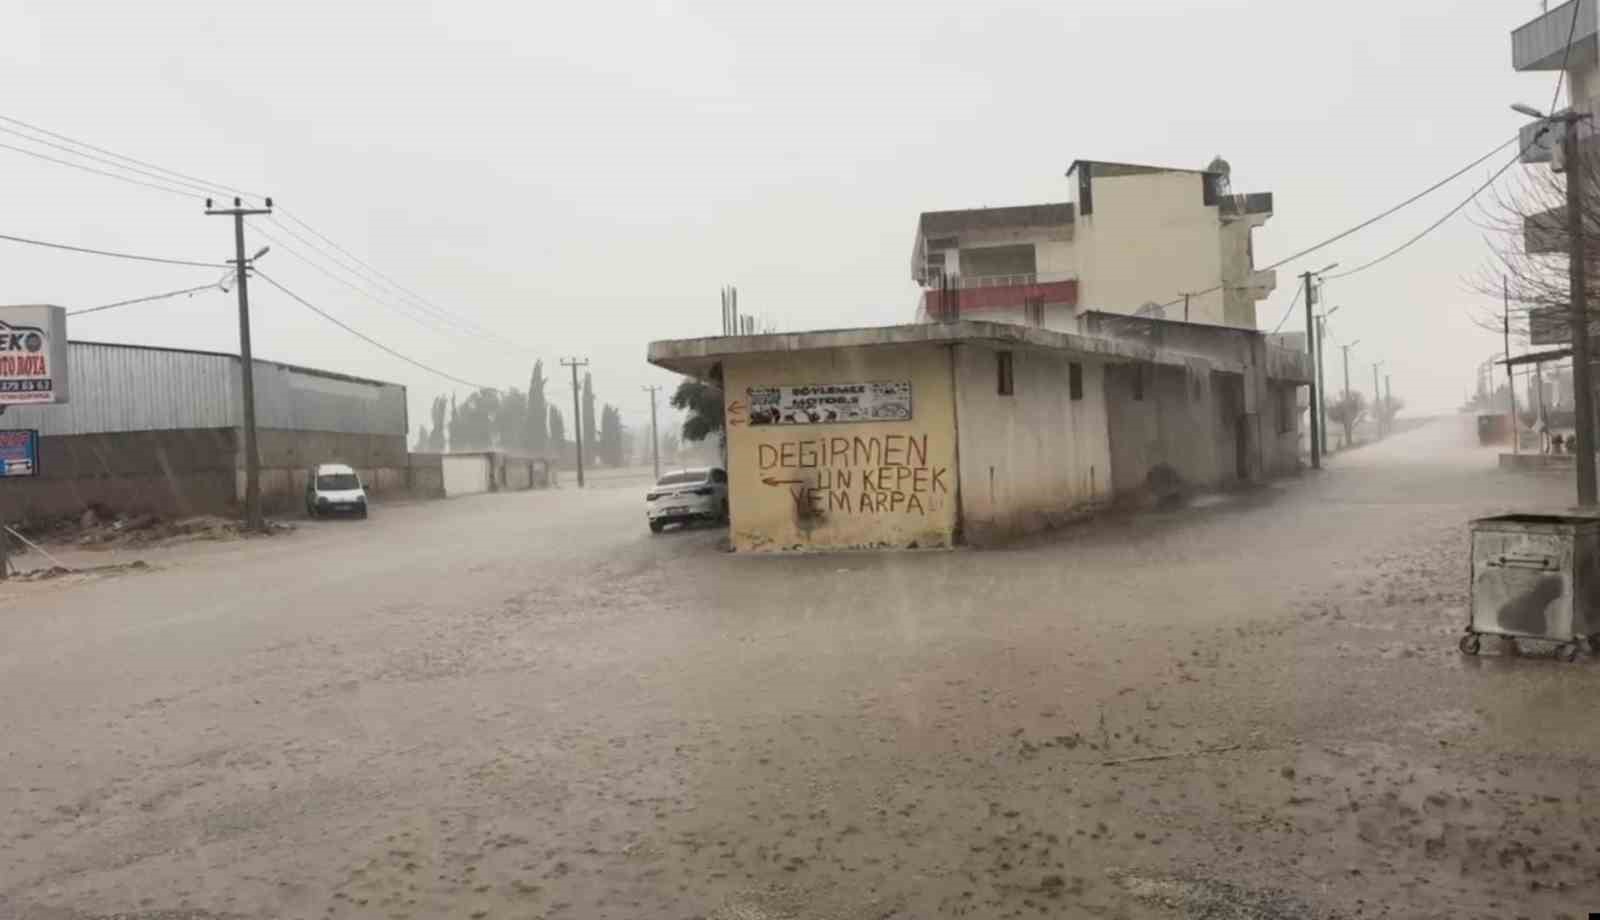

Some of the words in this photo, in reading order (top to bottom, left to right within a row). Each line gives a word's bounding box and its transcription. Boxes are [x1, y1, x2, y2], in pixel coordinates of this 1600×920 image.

[817, 468, 851, 490] UN
[863, 467, 948, 494] KEPEK
[790, 487, 851, 514] YEM
[860, 490, 925, 516] ARPA
